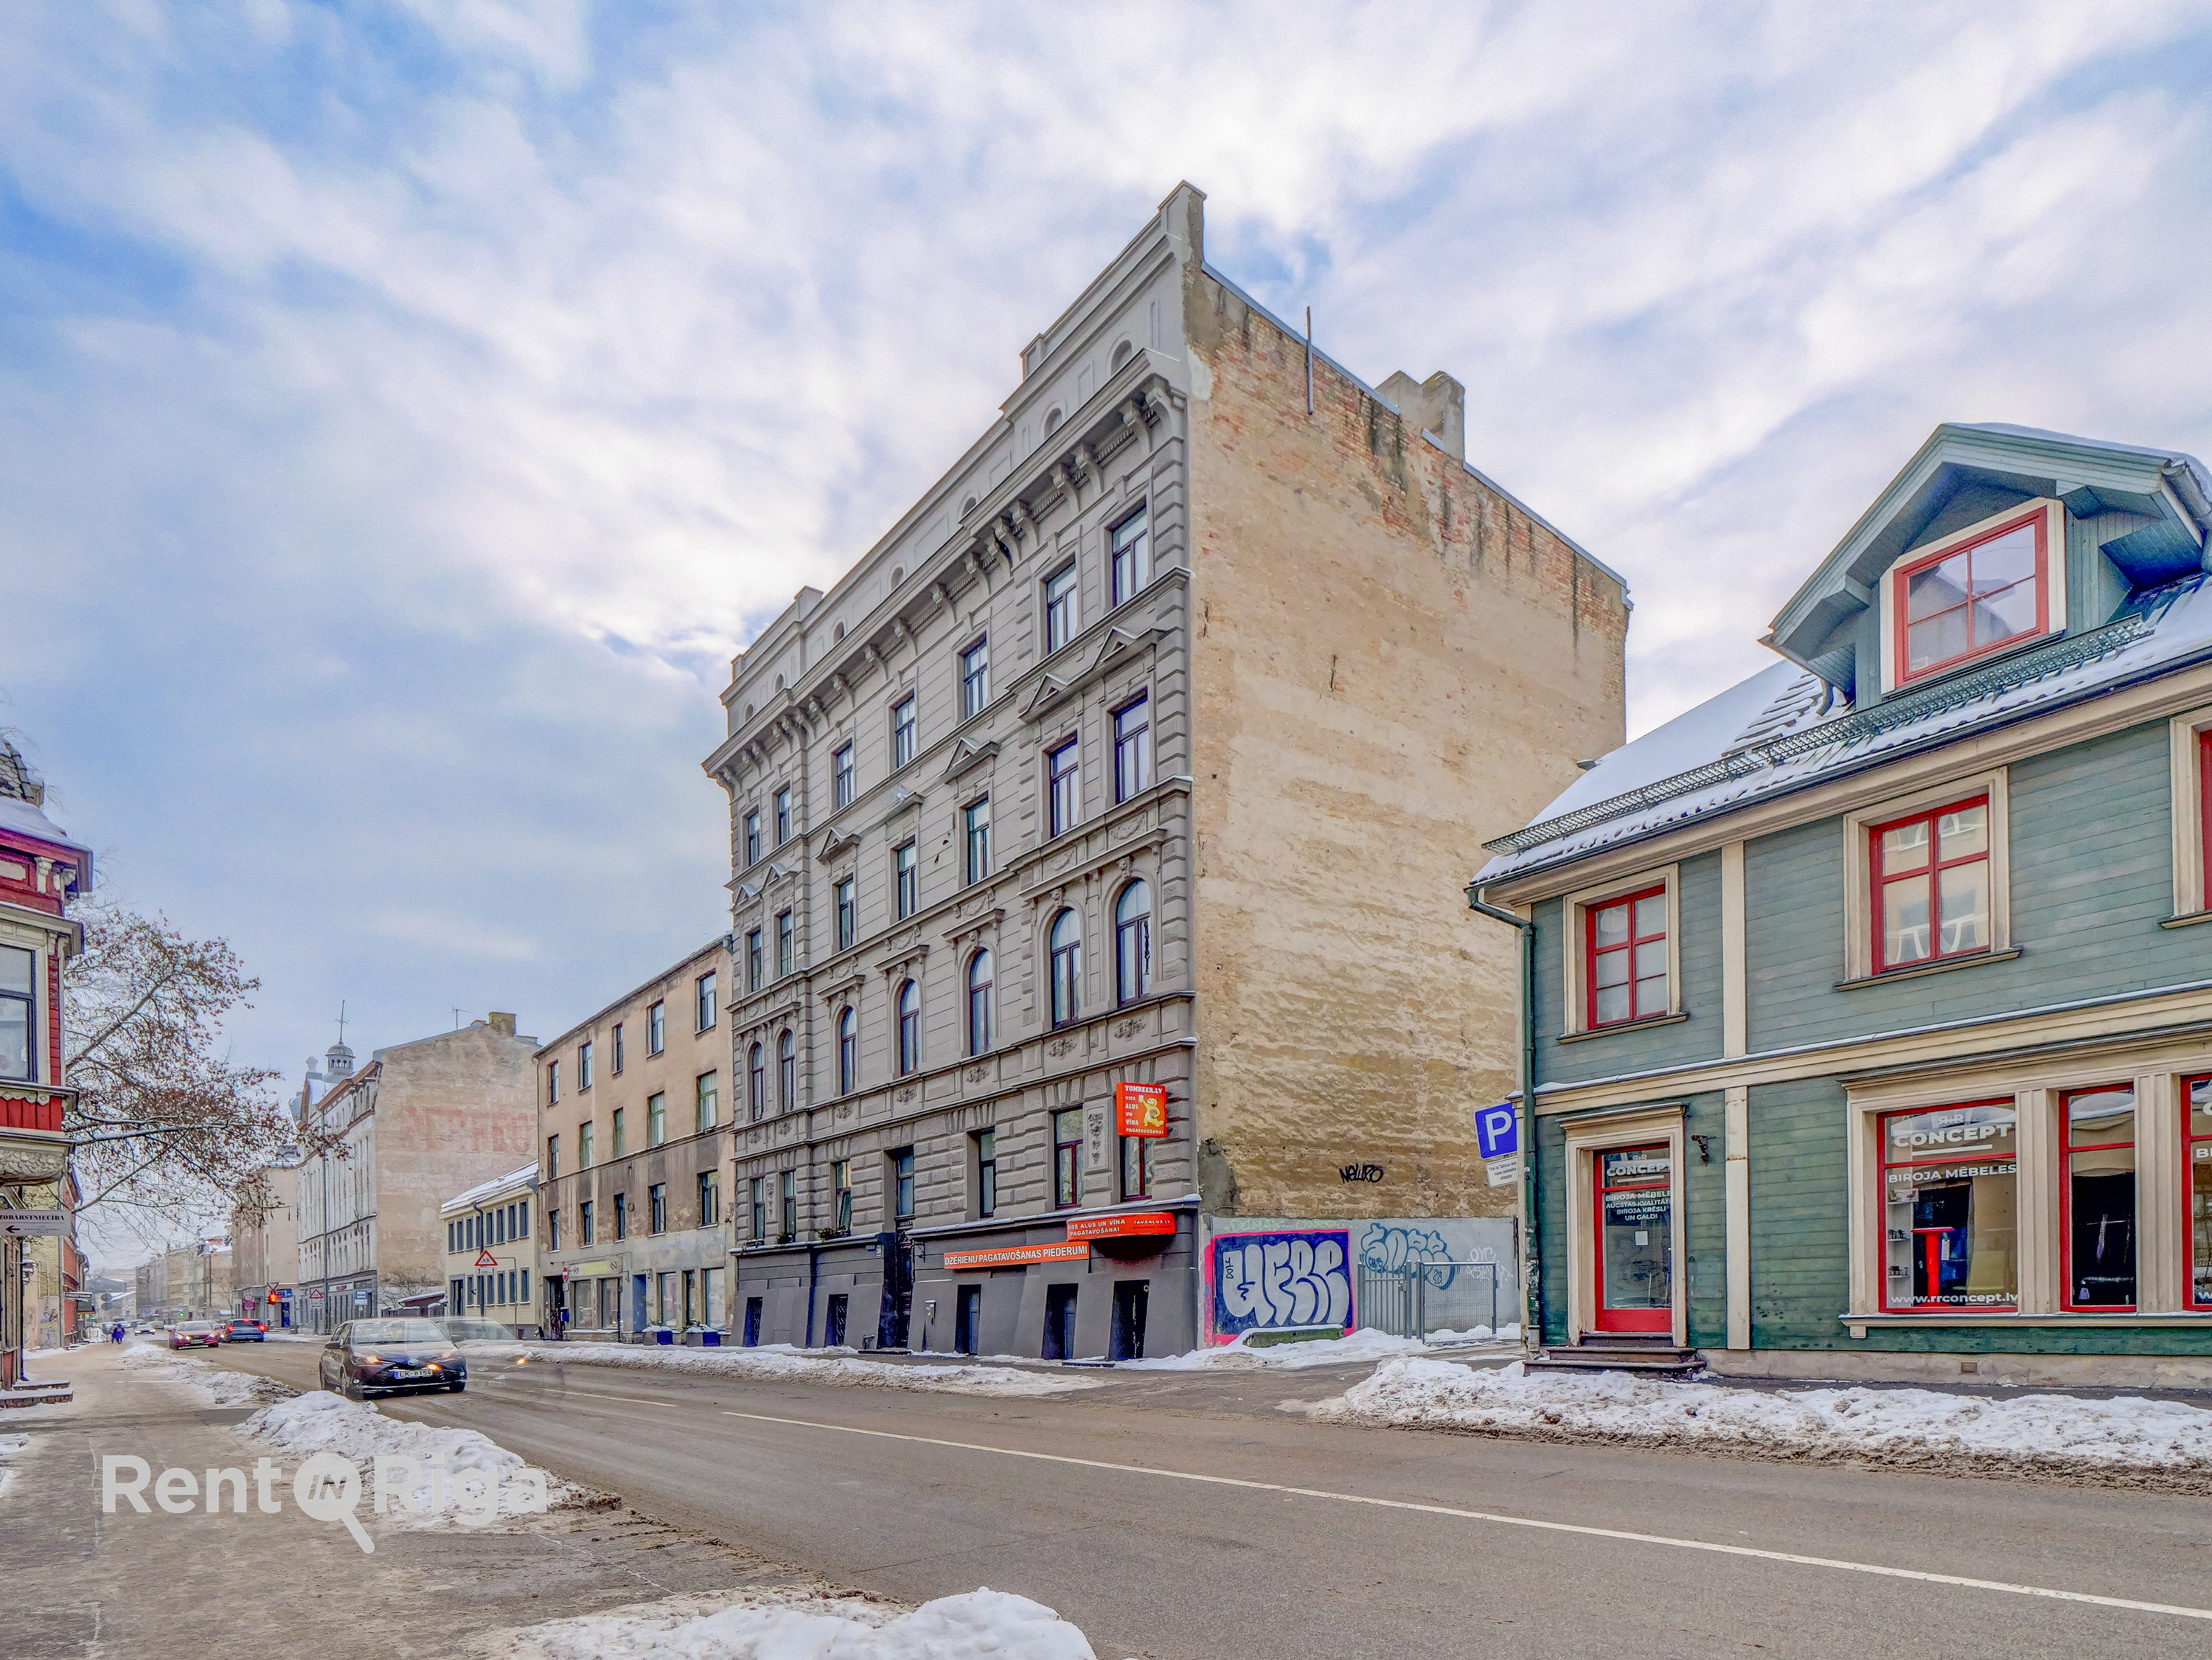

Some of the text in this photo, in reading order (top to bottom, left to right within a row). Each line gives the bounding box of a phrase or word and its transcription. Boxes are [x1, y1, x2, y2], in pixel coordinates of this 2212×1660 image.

[1124, 1086, 1162, 1094] TOMBEER.LV
[1485, 1111, 1512, 1151] P
[1893, 1123, 2012, 1147] CONCEPT
[1888, 1164, 2017, 1183] BIROJA MĒBELES
[1605, 1193, 1635, 1201] BIROJA
[1071, 1226, 1120, 1236] PAGATAVOŠANAI
[945, 1245, 1087, 1265] DZĒRIENU PAGATAVOŠANAS PIEDERUMI
[1891, 1292, 2018, 1303] www.rrconcept.lv
